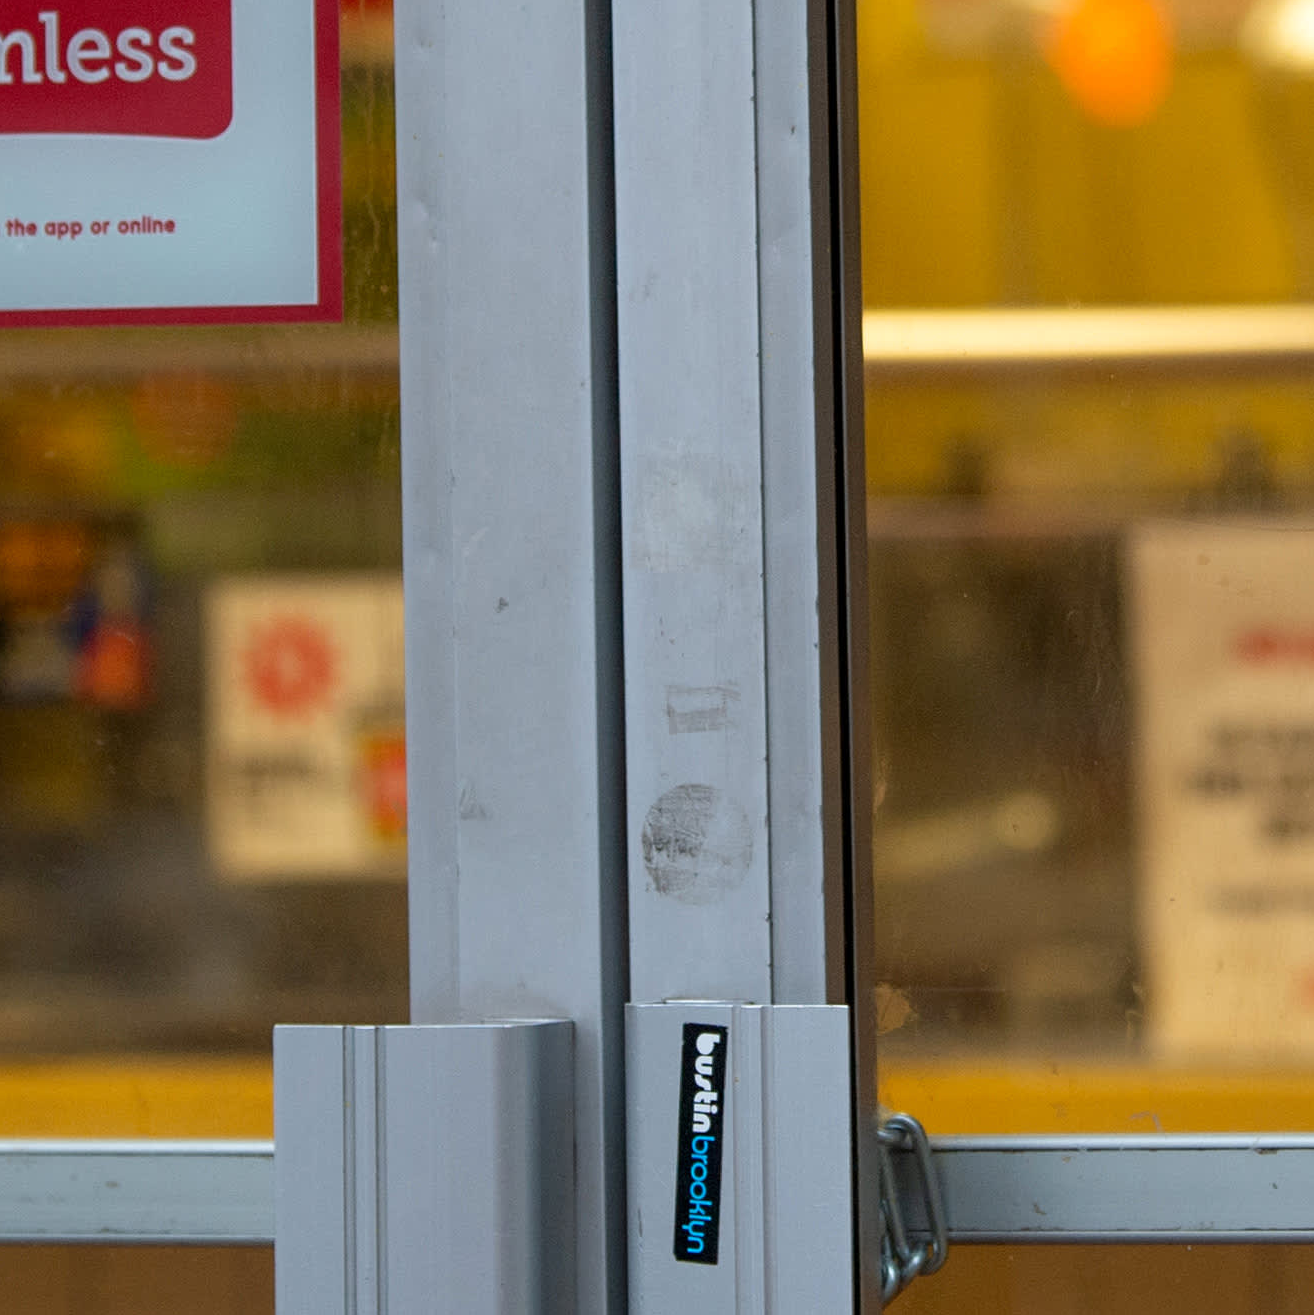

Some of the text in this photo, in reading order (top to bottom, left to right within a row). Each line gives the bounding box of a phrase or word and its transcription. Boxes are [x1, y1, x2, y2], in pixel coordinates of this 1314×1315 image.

[6, 219, 37, 236] the
[45, 222, 82, 239] app
[90, 221, 109, 234] or
[118, 216, 175, 234] online
